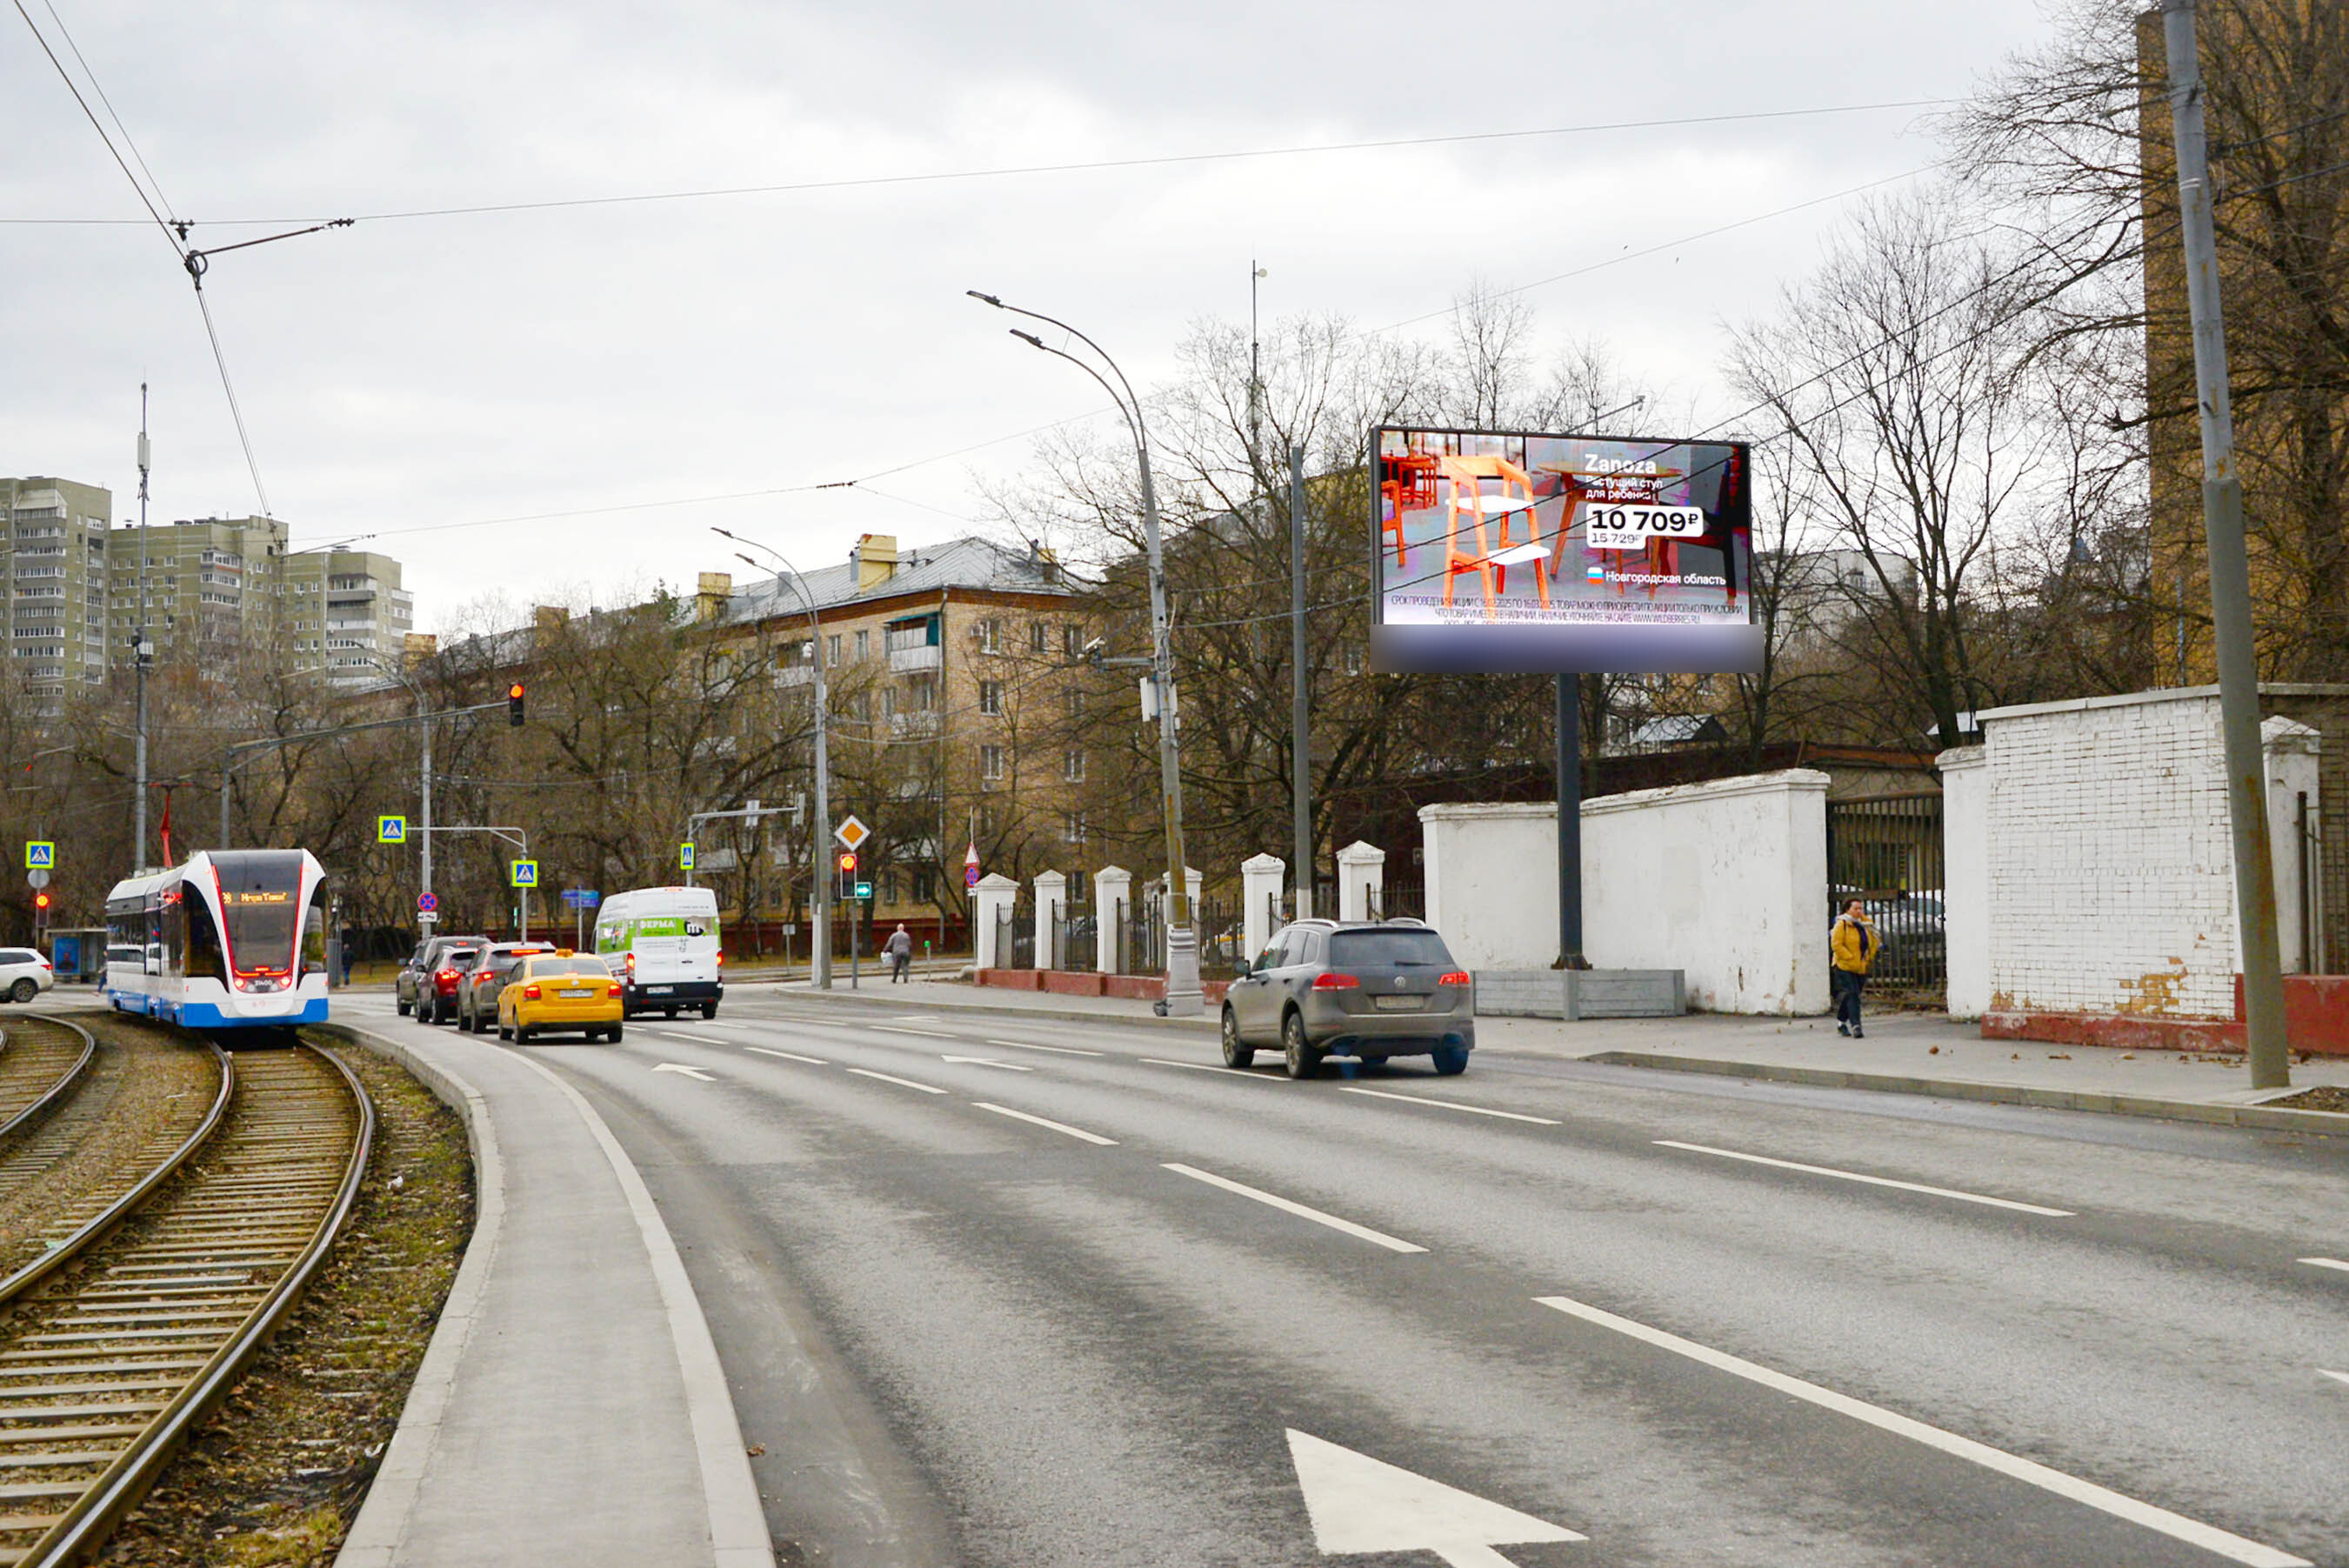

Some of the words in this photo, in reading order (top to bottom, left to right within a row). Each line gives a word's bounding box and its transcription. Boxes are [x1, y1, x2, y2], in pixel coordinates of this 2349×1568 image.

[1585, 453, 1657, 475] Zanoza
[1639, 479, 1663, 490] стул
[1585, 489, 1606, 500] для
[1592, 510, 1625, 530] 10
[1605, 570, 1682, 584] Новгородская
[1684, 573, 1726, 585] область
